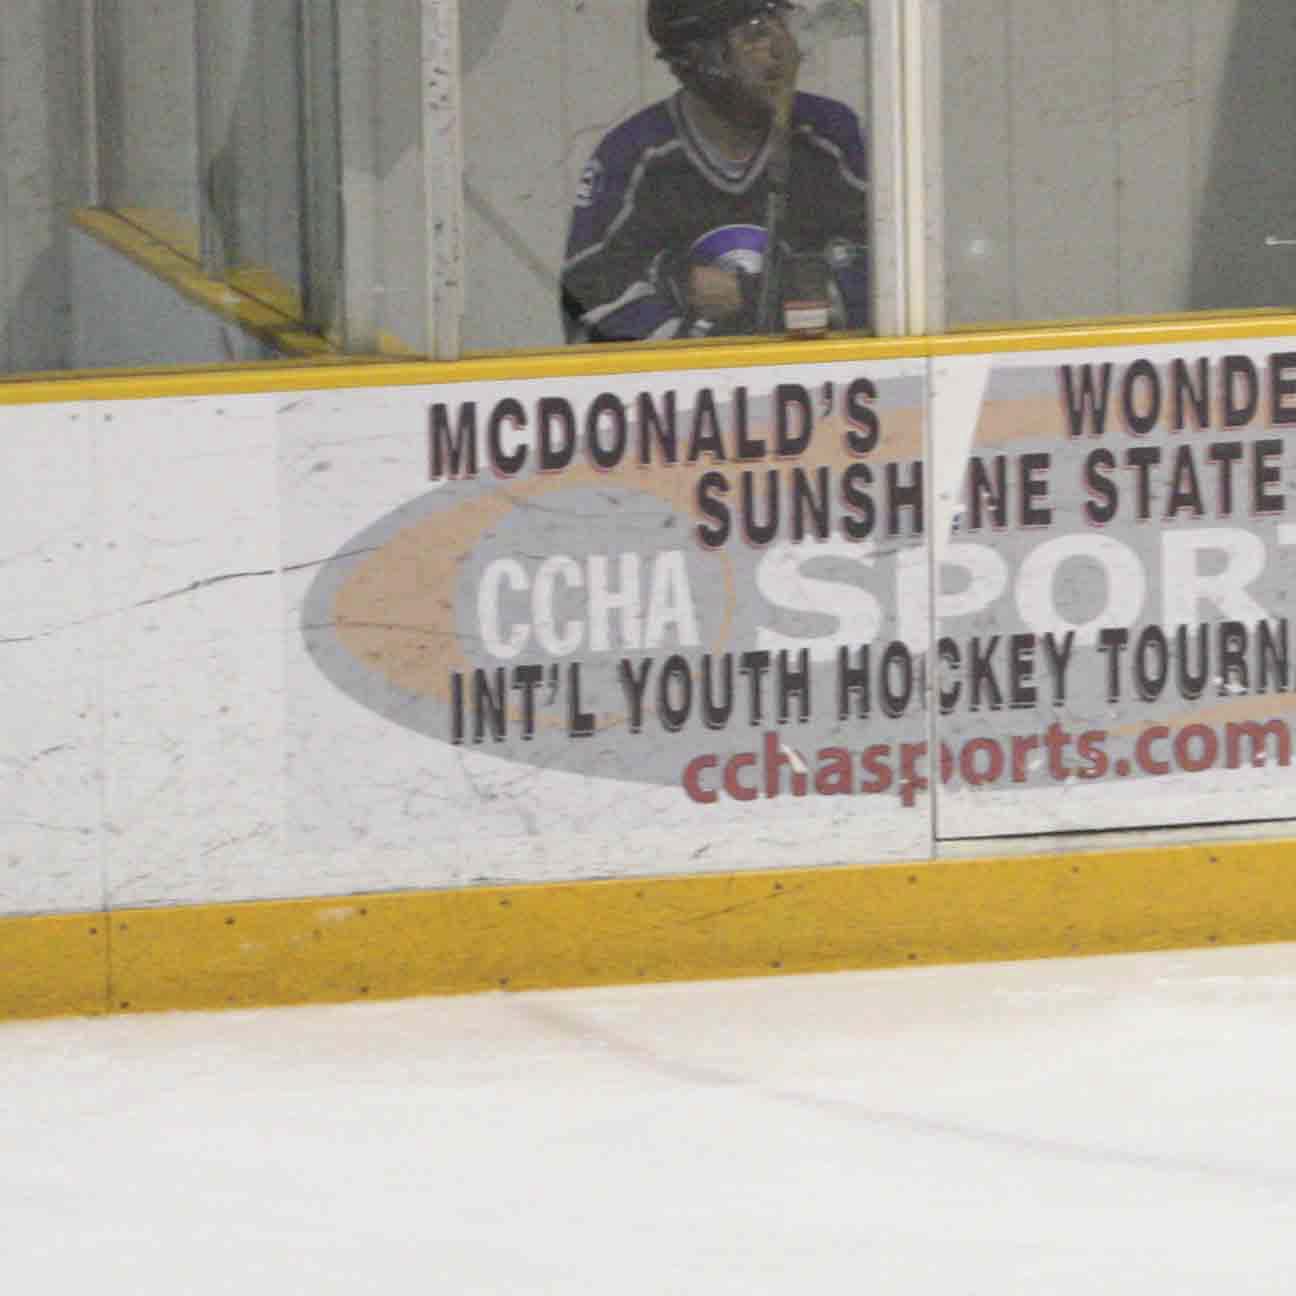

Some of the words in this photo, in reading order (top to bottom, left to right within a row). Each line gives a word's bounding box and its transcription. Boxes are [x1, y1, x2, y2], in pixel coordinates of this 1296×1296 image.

[428, 378, 878, 480] MCDONALD'S
[698, 452, 1051, 547] SUNSHNE
[1085, 440, 1287, 523] STATE
[476, 551, 699, 659] CCHA
[450, 657, 596, 744] INT'L
[620, 649, 809, 732] YOUTH
[837, 630, 1075, 720] HOCKEY
[683, 717, 1291, 807] cchasports.com
